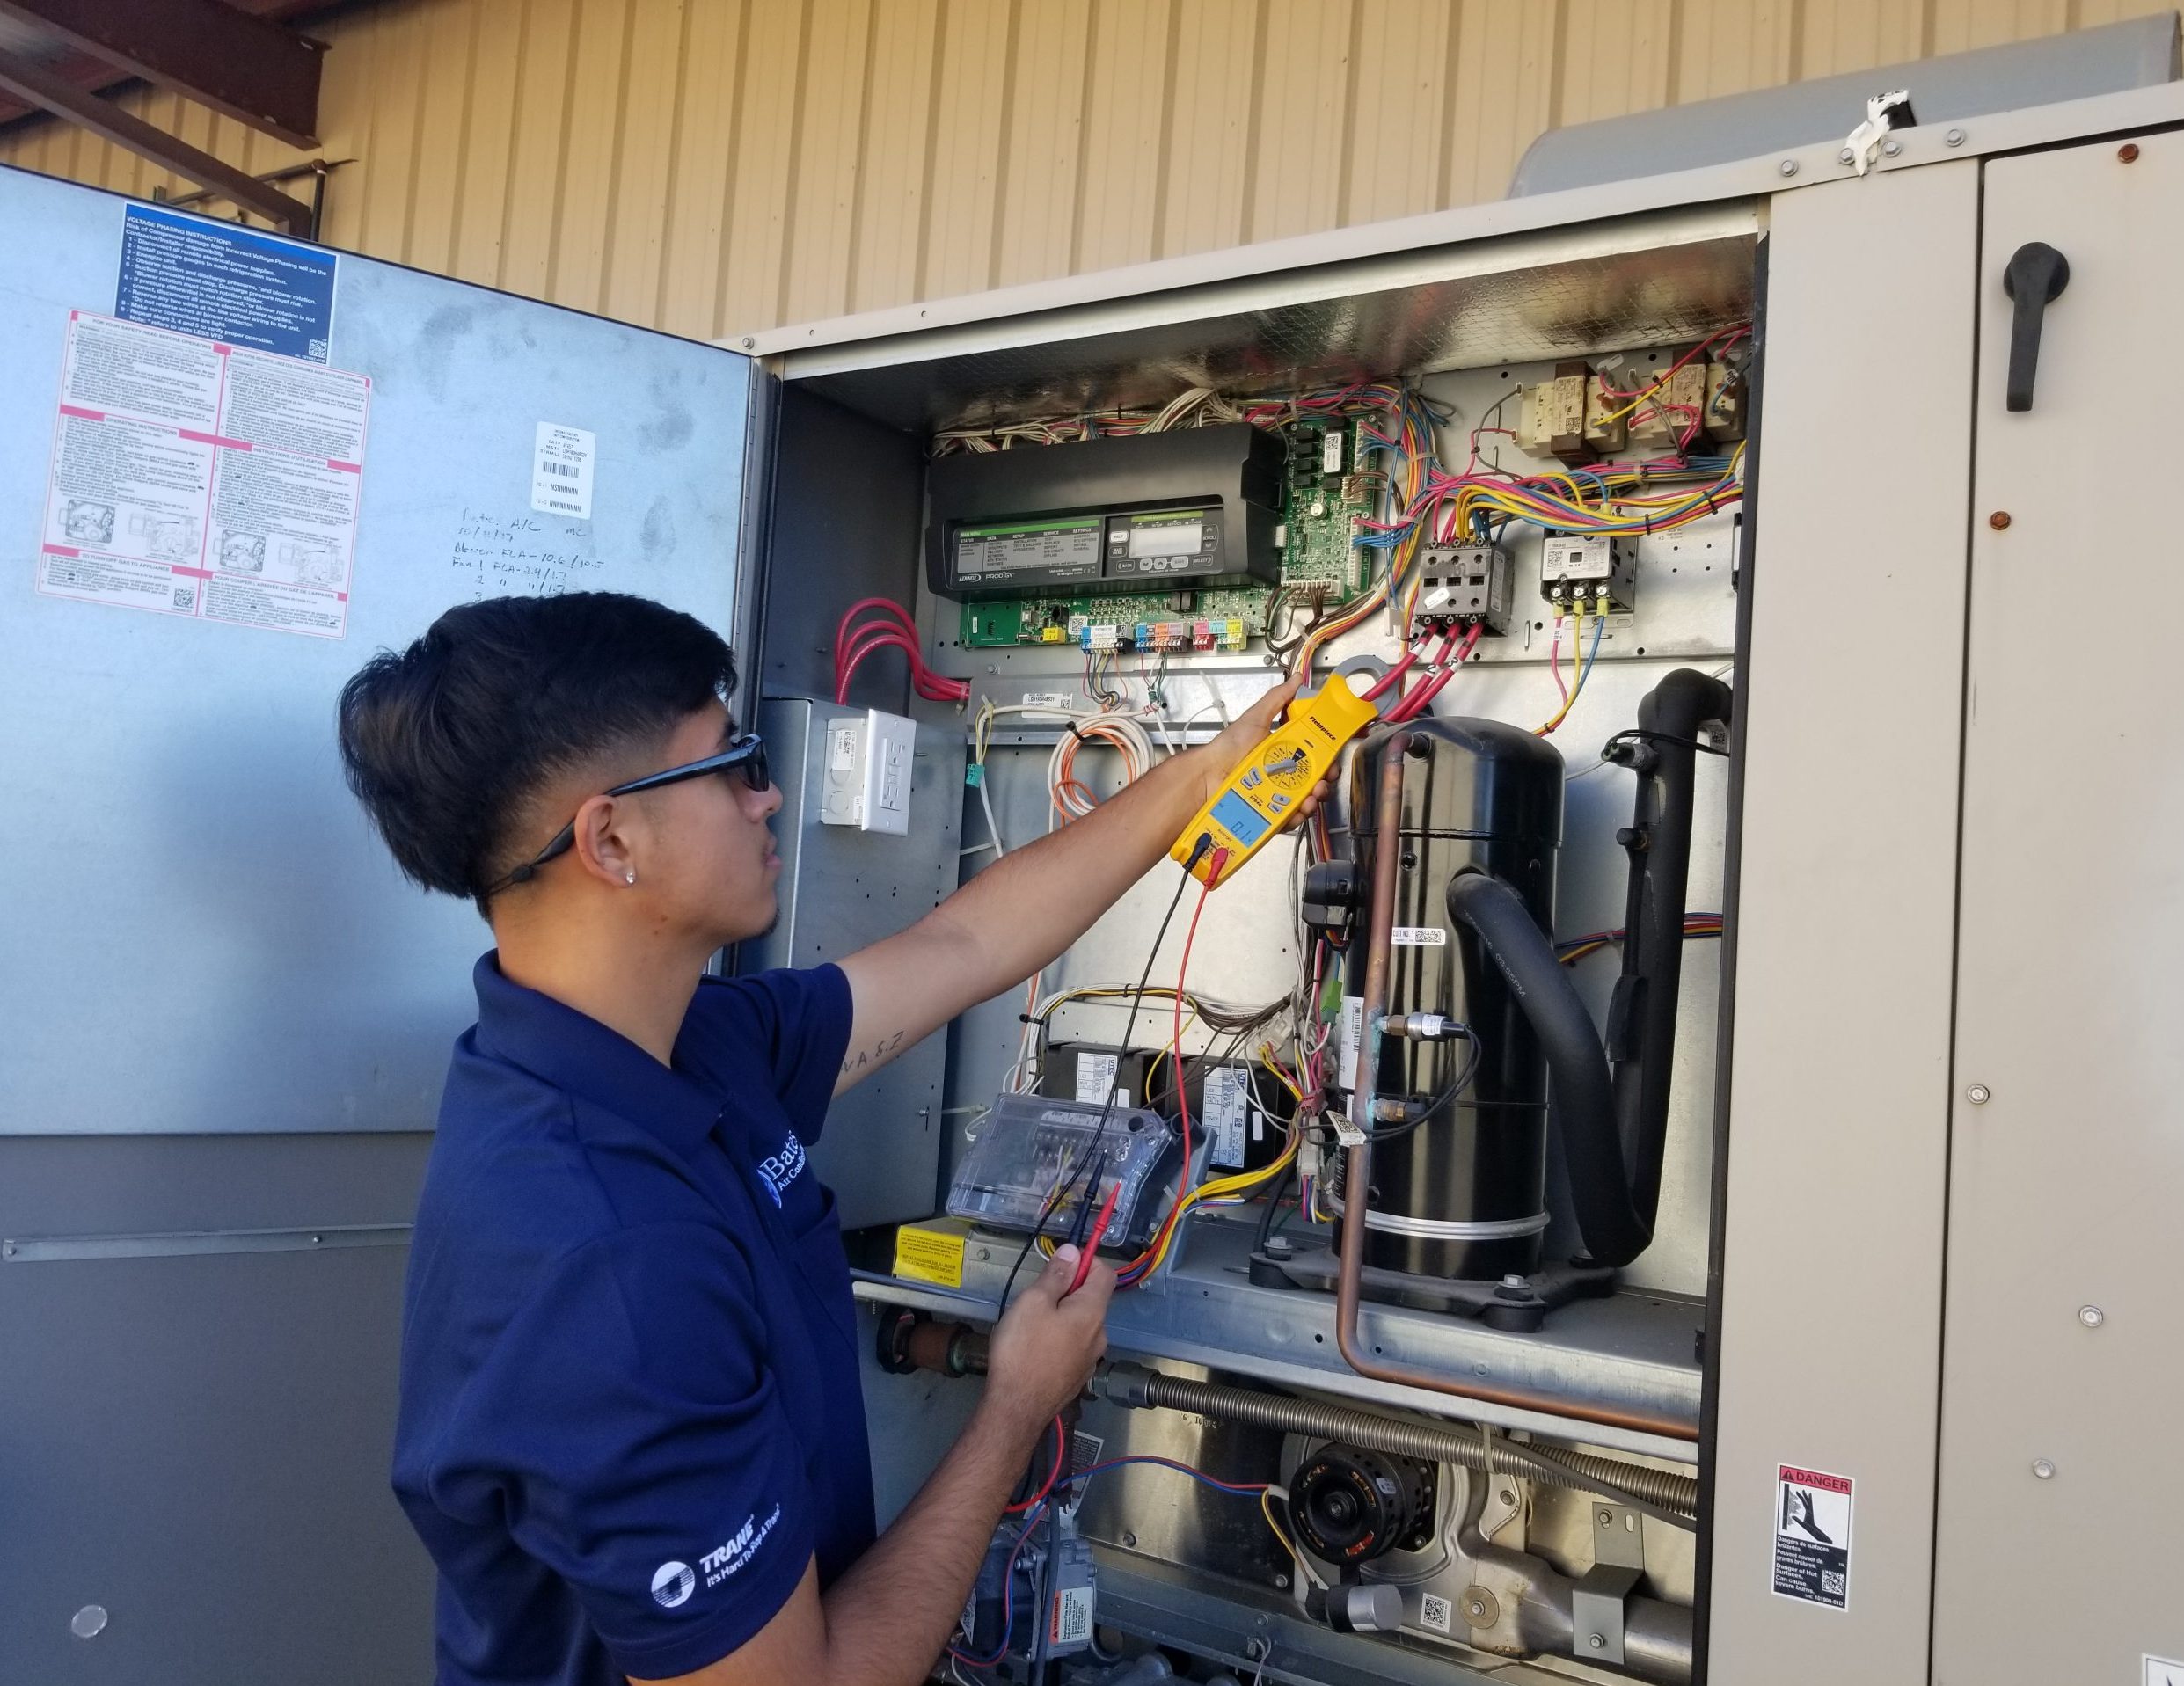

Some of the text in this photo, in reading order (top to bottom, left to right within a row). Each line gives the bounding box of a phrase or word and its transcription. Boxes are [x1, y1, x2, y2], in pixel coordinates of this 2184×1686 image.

[127, 215, 232, 246] VOLTAGE PHASING INSTRUCTIONS
[136, 251, 161, 261] Energize
[137, 237, 171, 251] Disconnect
[181, 249, 202, 259] remote
[203, 255, 230, 266] electrical
[230, 261, 248, 270] power
[148, 227, 185, 241] Compressor
[186, 237, 209, 248] damage
[252, 253, 274, 263] Voltage
[274, 259, 297, 269] Phasing
[137, 245, 155, 253] Install
[157, 250, 183, 260] pressure
[184, 256, 205, 266] gauges
[229, 267, 264, 281] refrigeration
[266, 276, 287, 286] system.
[135, 257, 160, 267] Observe
[162, 264, 184, 273] suction
[198, 272, 226, 284] discharge
[273, 289, 292, 299] blower
[135, 263, 158, 274] Suction
[159, 270, 185, 281] pressure
[218, 283, 247, 296] Discharge
[249, 291, 274, 302] pressure
[159, 276, 183, 286] rotation
[220, 291, 241, 300] rotation
[1309, 716, 1336, 741] Fieldpiece
[778, 1177, 792, 1191] Air
[1796, 1471, 1849, 1491] DANGER
[699, 1518, 753, 1573] TRANE
[1777, 1536, 1798, 1545] Dangers
[1807, 1543, 1830, 1552] surfaces
[1777, 1548, 1796, 1558] Peuvent
[706, 1573, 721, 1587] It's
[721, 1556, 744, 1579] Hard
[742, 1550, 752, 1562] To
[749, 1533, 763, 1554] Stop
[761, 1526, 768, 1537] A
[1777, 1562, 1798, 1573] Danger
[1775, 1567, 1803, 1580] Surfaces.
[1788, 1578, 1807, 1587] cause
[1795, 1585, 1815, 1595] burns.
